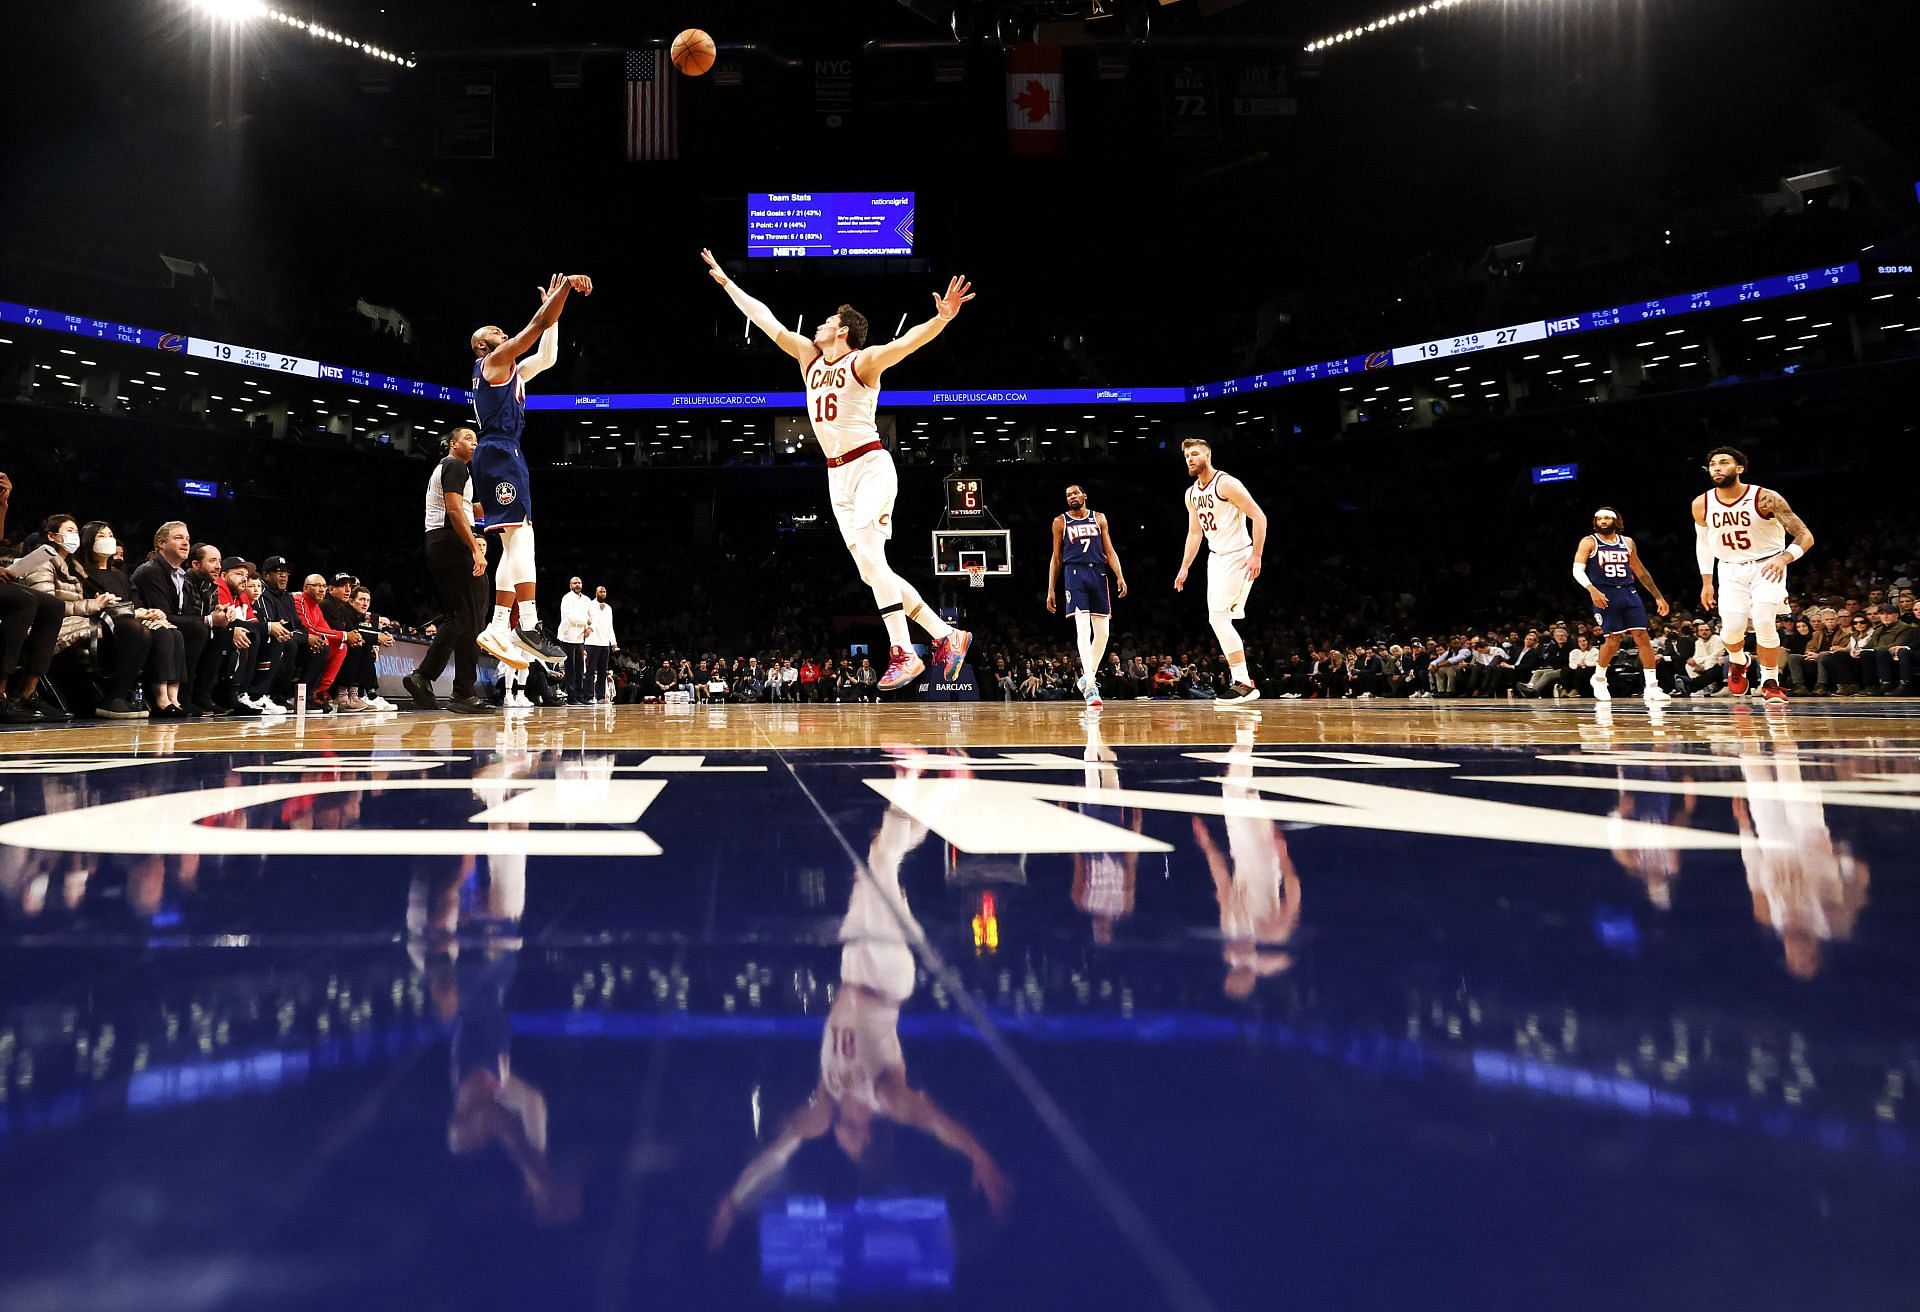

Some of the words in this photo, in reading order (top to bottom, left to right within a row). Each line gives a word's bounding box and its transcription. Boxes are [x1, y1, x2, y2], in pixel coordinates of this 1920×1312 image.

[816, 60, 852, 75] NYC
[1174, 96, 1206, 115] 72
[773, 248, 806, 256] NETS
[1824, 266, 1845, 276] AST
[1787, 274, 1808, 283] REB
[1691, 292, 1708, 300] 3PT
[65, 316, 82, 324] REB
[1592, 310, 1612, 318] FLS:
[1547, 318, 1580, 336] NETS
[1594, 319, 1614, 327] TOL:
[118, 326, 134, 334] FLS:
[1496, 329, 1518, 344] 27
[117, 334, 134, 342] TOL:
[1454, 335, 1478, 348] 2:19
[214, 345, 231, 358] 19
[1420, 344, 1438, 358] 19
[1460, 344, 1484, 353] Quarter
[245, 350, 266, 362] 2:19
[280, 358, 298, 370] 27
[1306, 364, 1318, 372] AST
[320, 365, 344, 379] NETS
[811, 368, 846, 390] CAVS
[672, 396, 766, 406] JETBLUEPLUSCARD.COM
[933, 394, 1028, 402] JETBLUEPLUSCARD.COM
[816, 393, 838, 422] 16
[956, 482, 978, 492] 2:19
[966, 492, 976, 508] 6
[1193, 494, 1214, 510] CAVS
[1199, 512, 1218, 532] 32
[1712, 511, 1751, 528] CAVS
[1066, 524, 1101, 544] NETS
[1722, 530, 1752, 550] 45
[1080, 538, 1090, 552] 7
[1598, 550, 1629, 564] NETS
[1604, 564, 1626, 578] 95
